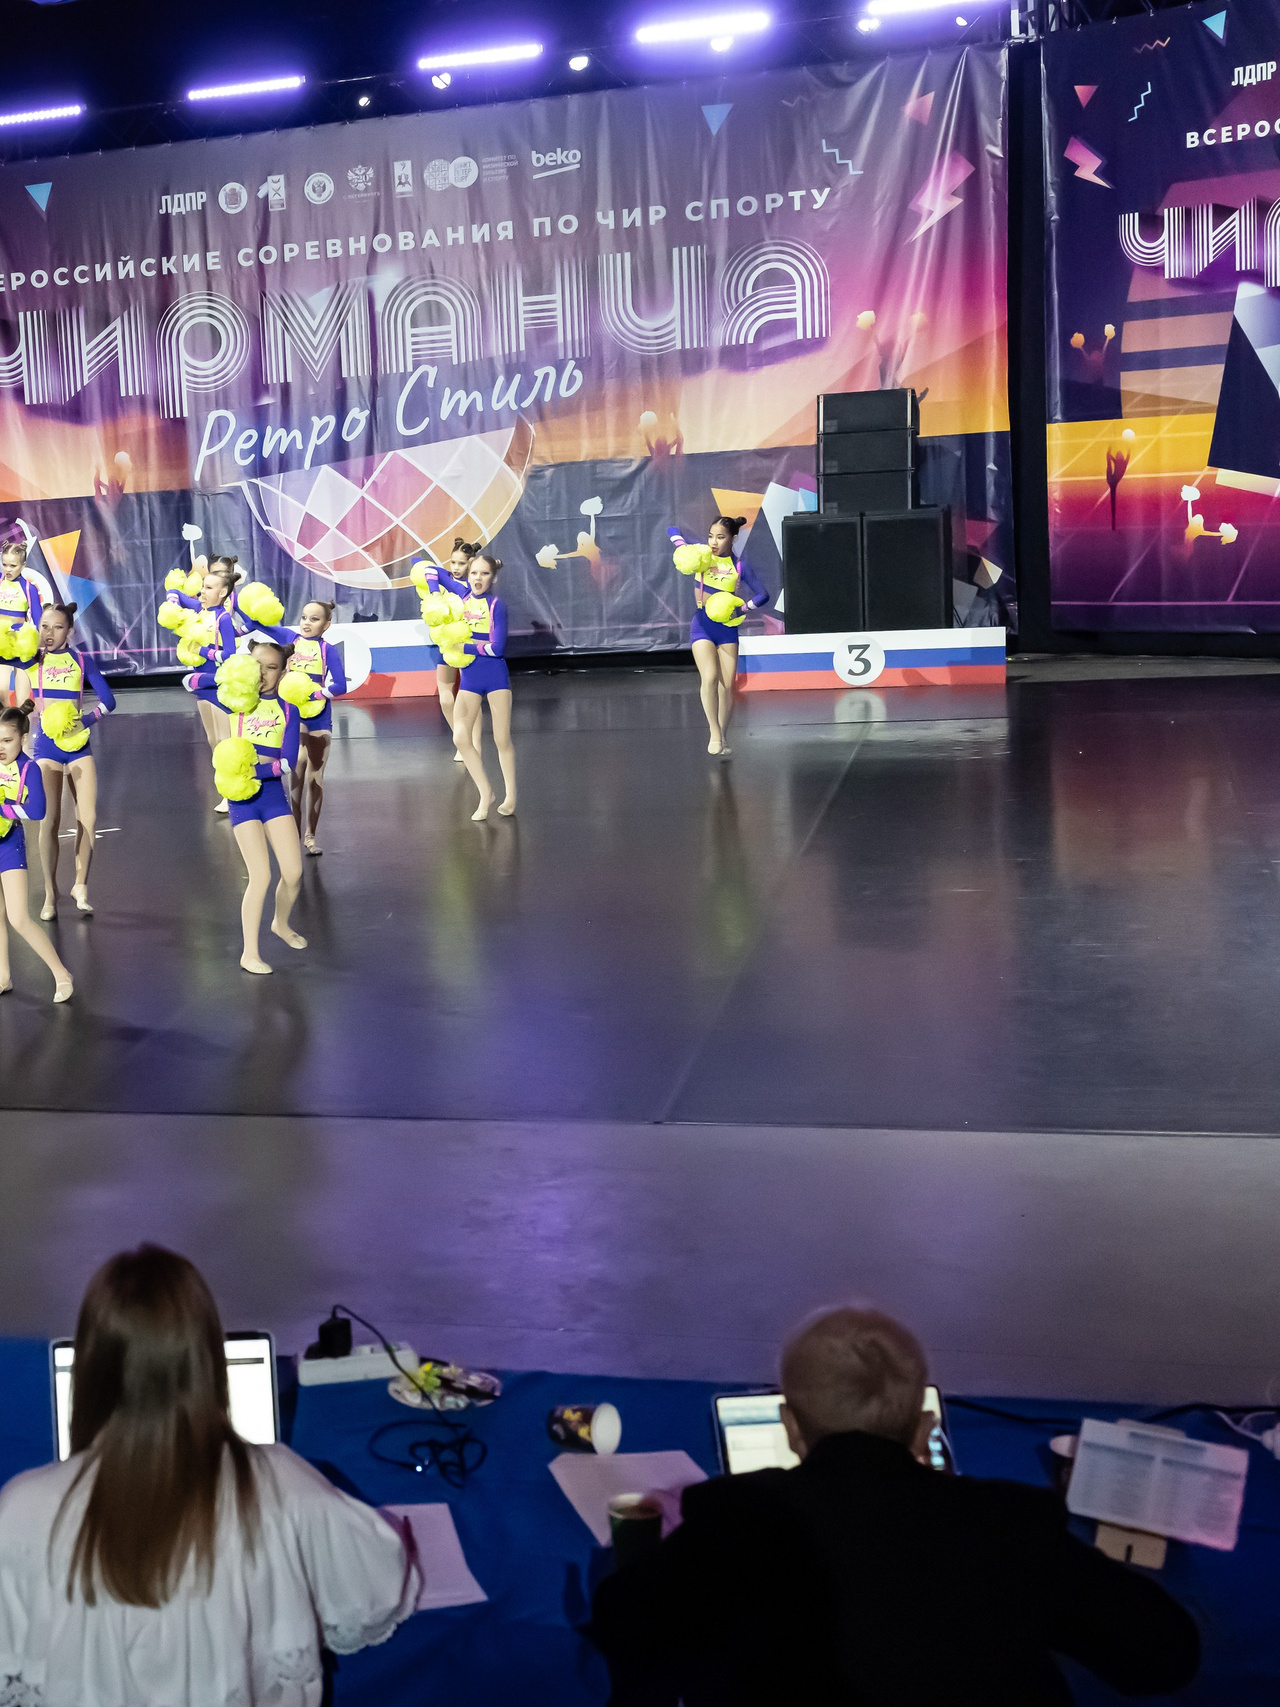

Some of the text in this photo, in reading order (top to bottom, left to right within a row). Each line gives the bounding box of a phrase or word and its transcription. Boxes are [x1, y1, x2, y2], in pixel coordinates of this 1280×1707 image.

[1231, 61, 1277, 87] ЛДПР
[531, 148, 581, 167] beko
[158, 191, 207, 216] ЛДПР
[237, 220, 514, 268] СОРЕВНОВАНИЯ
[532, 214, 580, 238] ПО
[596, 205, 667, 230] ЧИР
[685, 187, 832, 222] СПОРТУ
[194, 360, 583, 482] Ретро Стиль
[847, 644, 872, 677] 3
